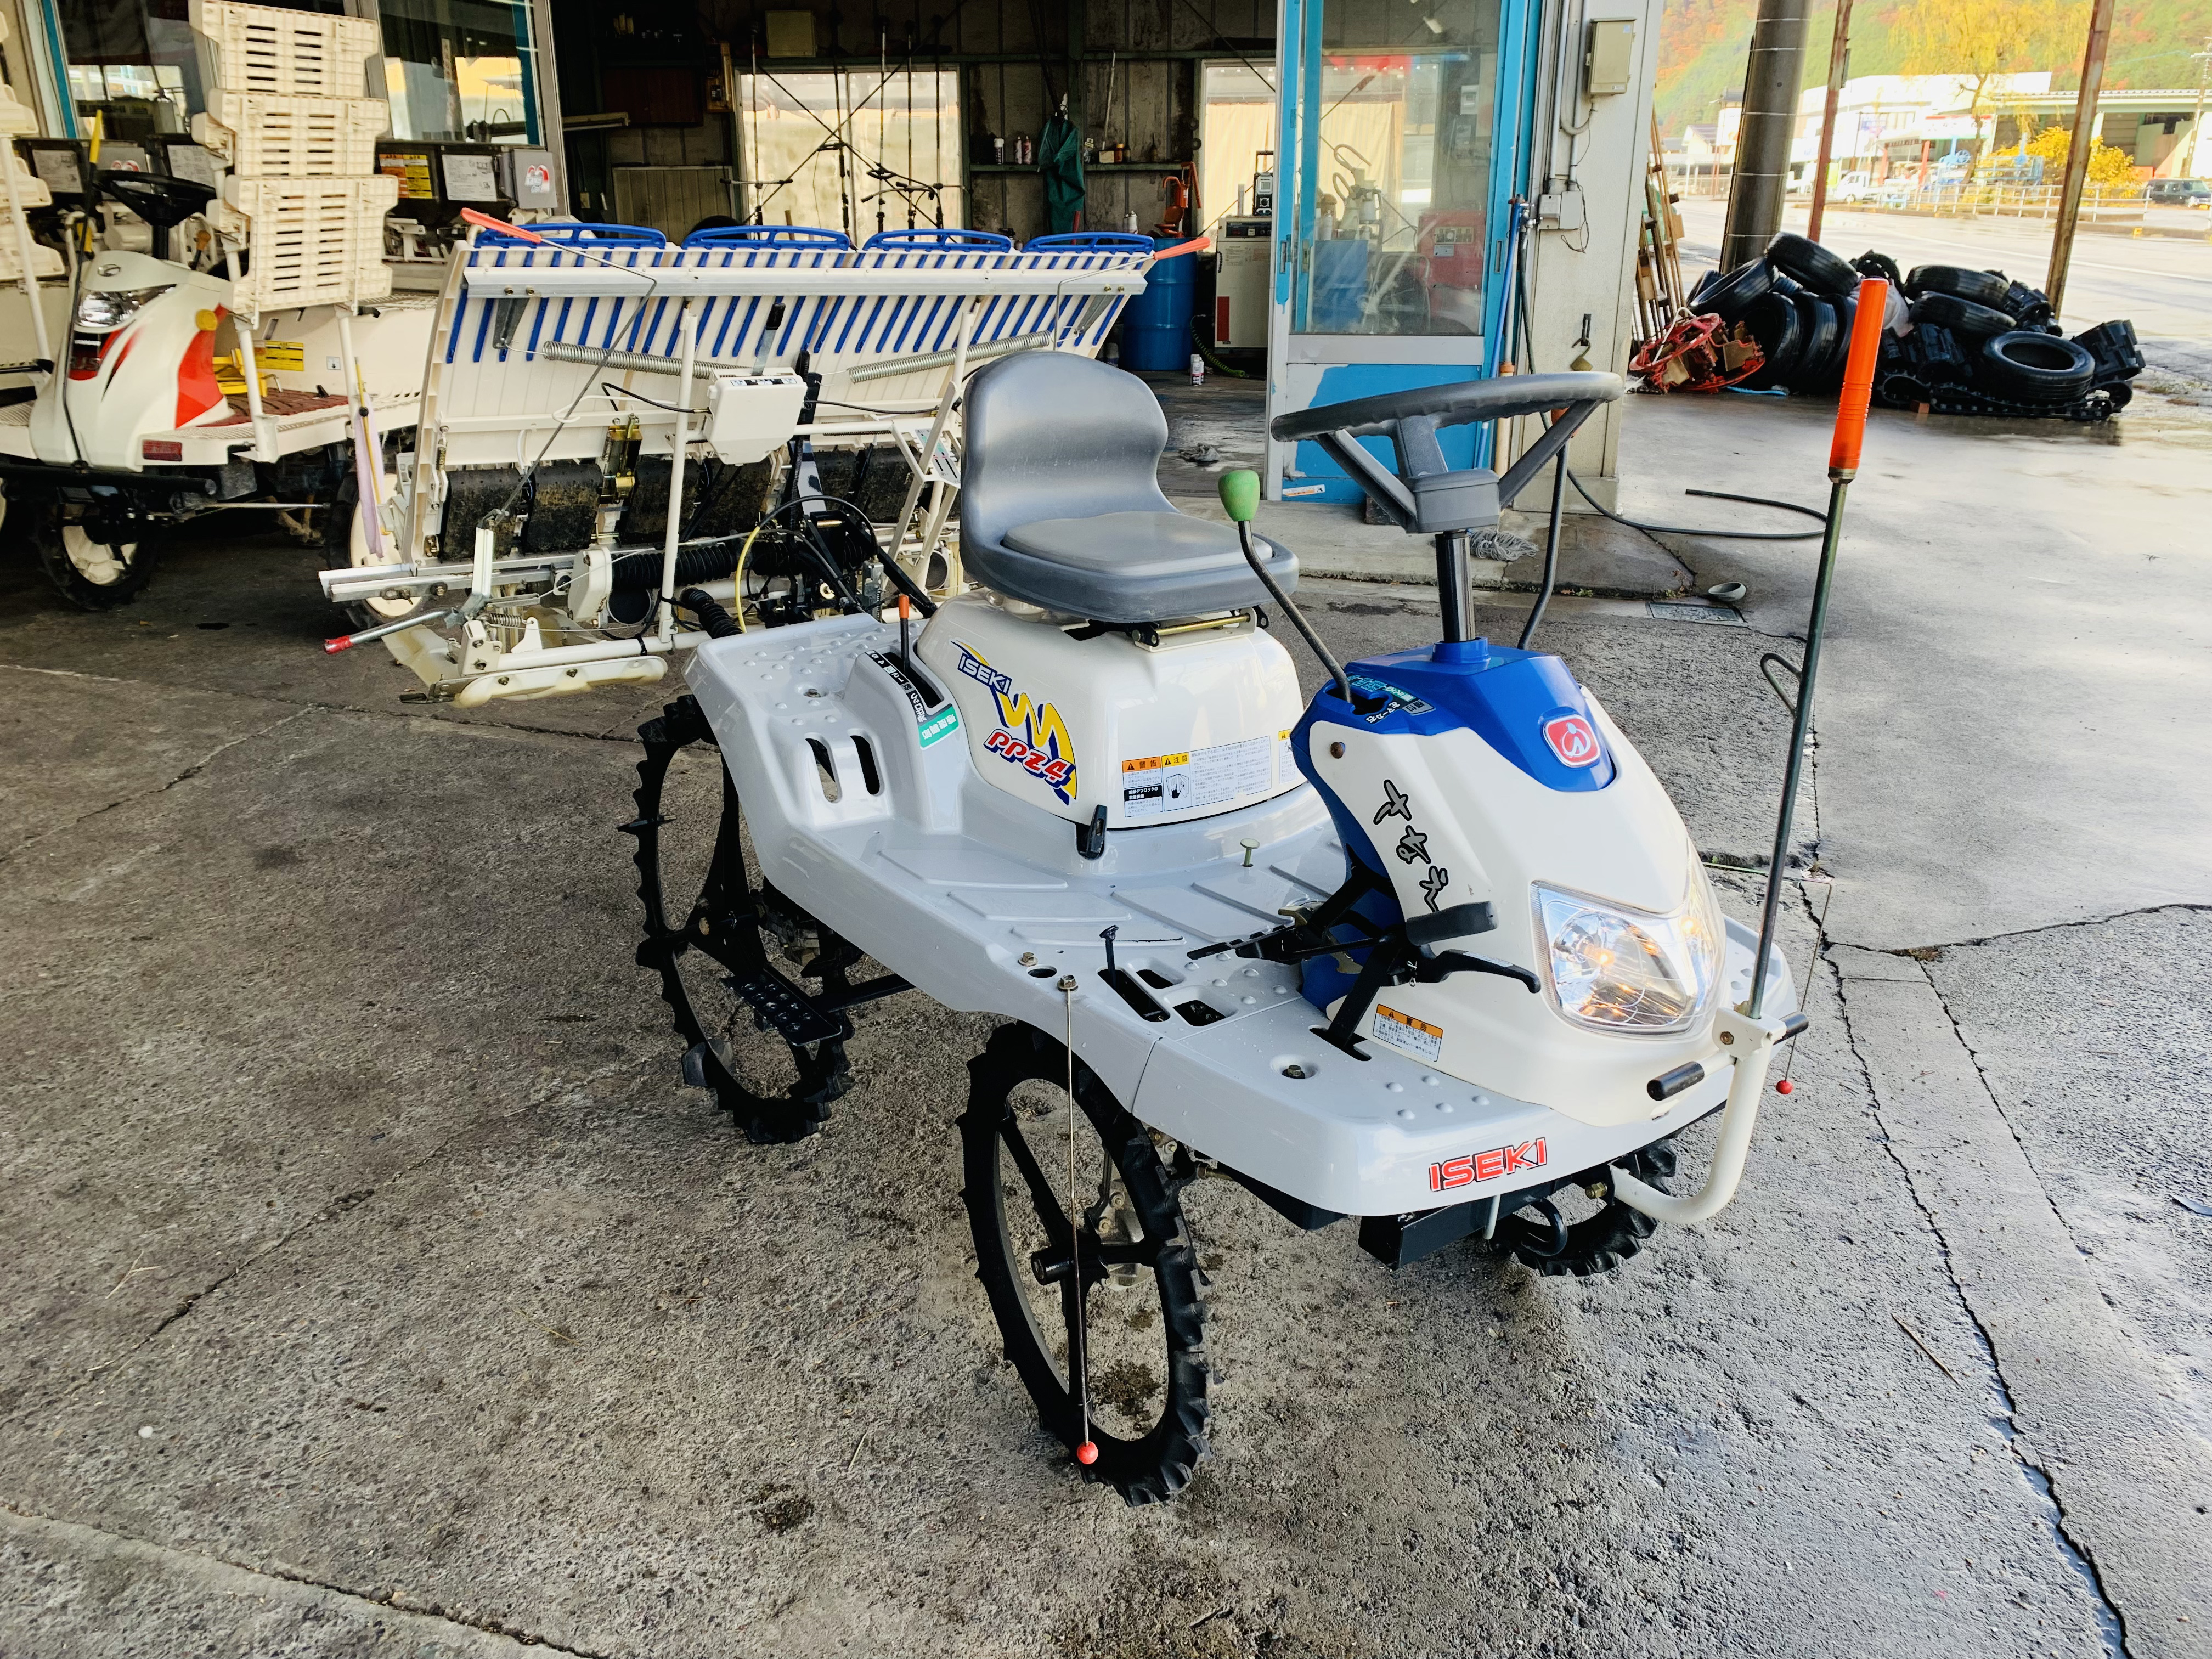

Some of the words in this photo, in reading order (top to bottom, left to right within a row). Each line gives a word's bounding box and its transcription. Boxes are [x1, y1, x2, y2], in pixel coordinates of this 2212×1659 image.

[958, 654, 1011, 694] ISEKI
[986, 730, 1069, 782] PPZ4
[1139, 760, 1156, 769] 警告
[1373, 779, 1449, 912] さなえ
[1406, 1017, 1427, 1031] 警告
[1429, 1137, 1548, 1192] ISEKI
